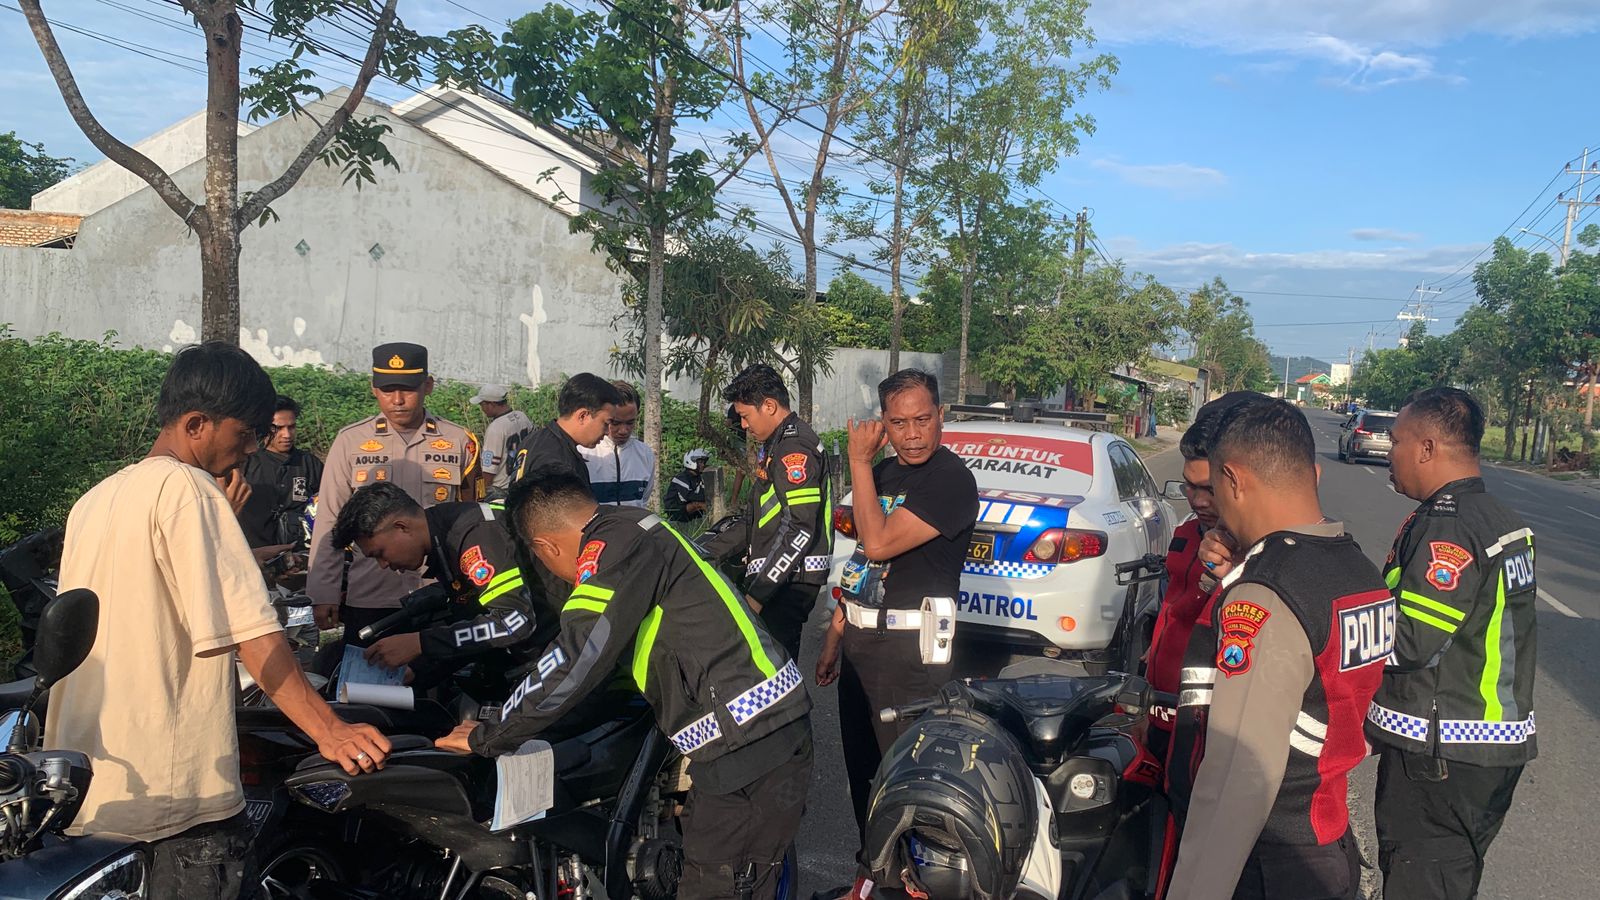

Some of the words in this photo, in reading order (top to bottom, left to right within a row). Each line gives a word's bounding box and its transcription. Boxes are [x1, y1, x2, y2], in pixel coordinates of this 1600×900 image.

[356, 456, 389, 465] AGUS.P
[425, 454, 458, 464] POLRI
[941, 442, 984, 455] LRI
[988, 444, 1064, 465] UNTUK
[984, 489, 1063, 506] ISI
[767, 529, 811, 583] POLISI
[973, 544, 990, 559] 67
[957, 591, 1038, 621] PATROL
[1225, 604, 1266, 619] POLRES
[1344, 604, 1396, 666] POLIS
[500, 647, 565, 723] POLSI
